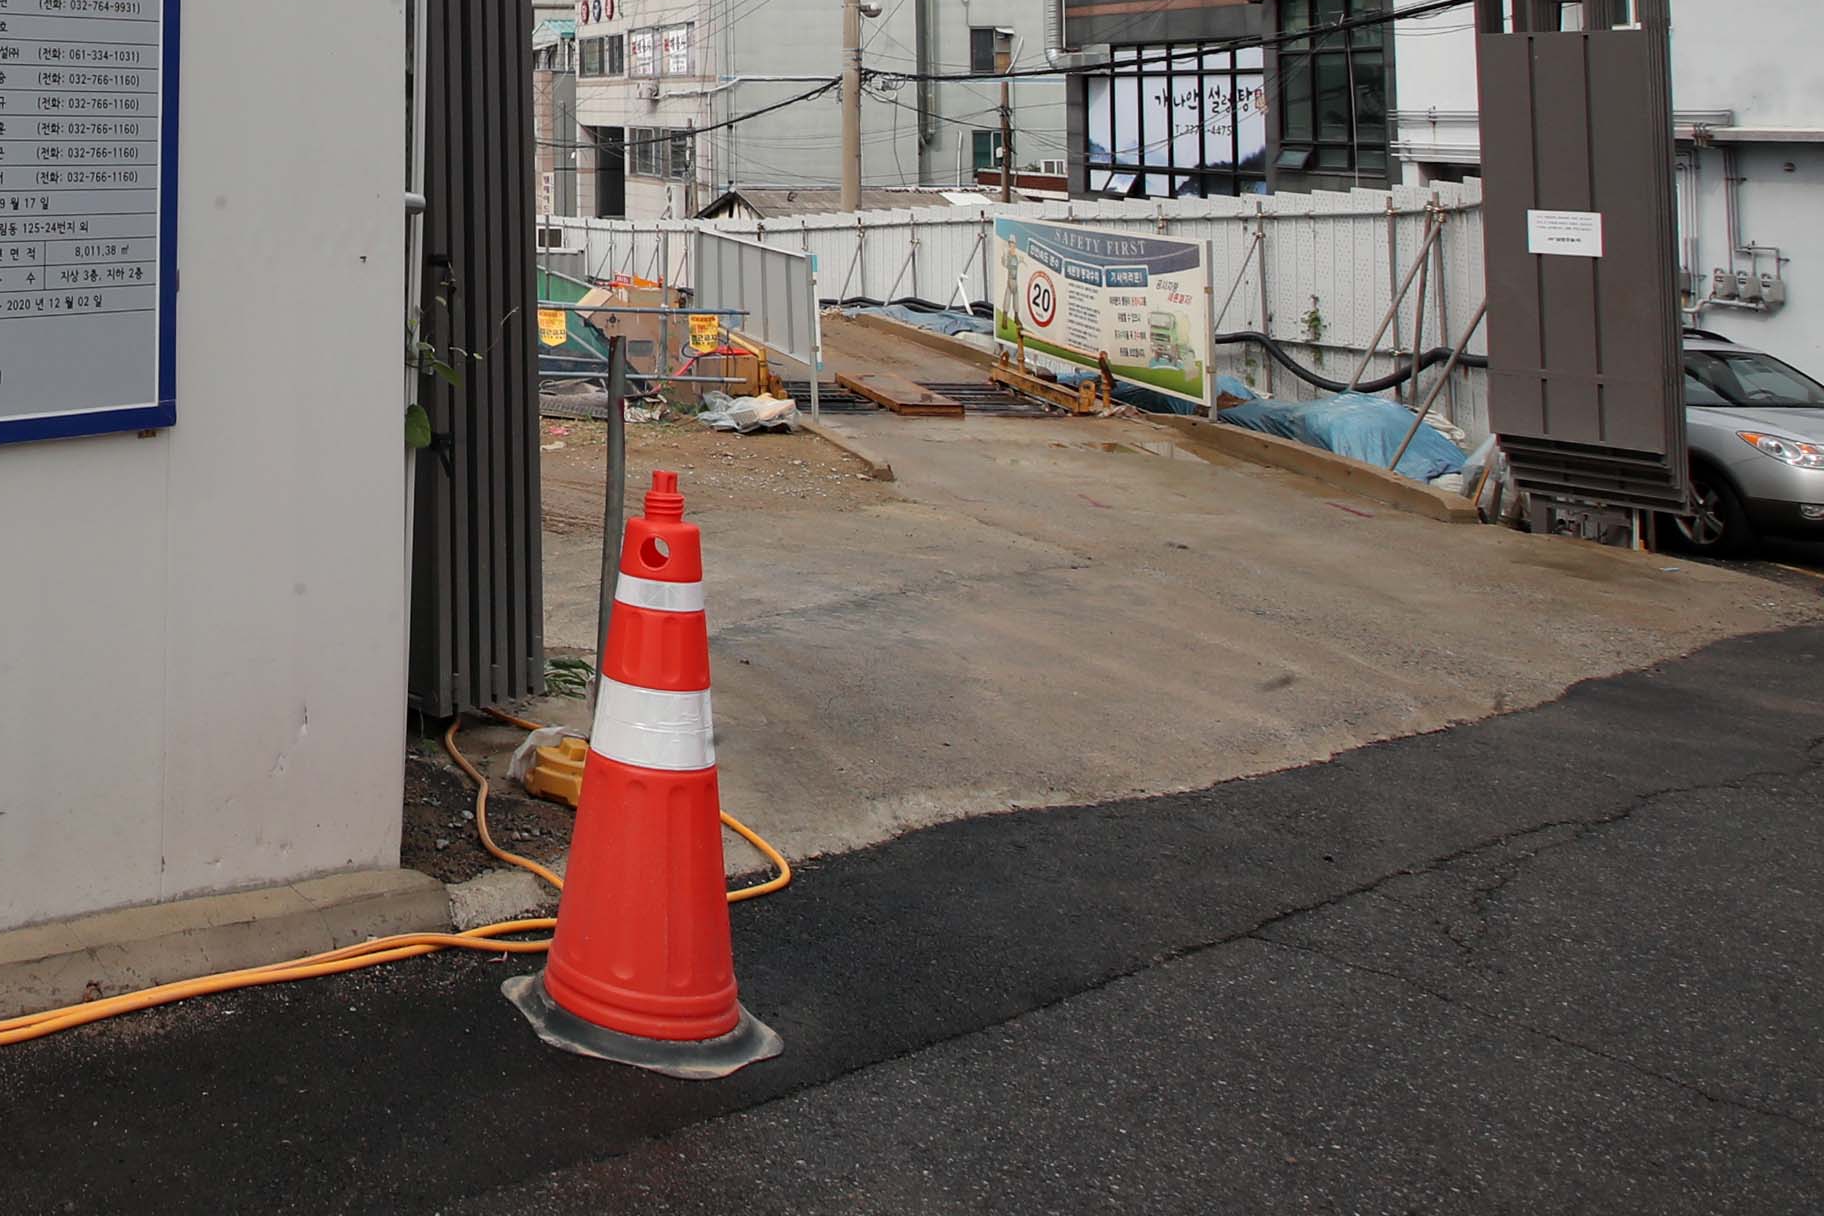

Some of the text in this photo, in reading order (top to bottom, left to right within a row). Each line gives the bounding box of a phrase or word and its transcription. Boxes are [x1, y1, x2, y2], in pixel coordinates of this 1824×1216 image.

[24, 198, 36, 209] 17
[40, 197, 49, 210] 일
[23, 221, 75, 235] 125-24번지
[1055, 230, 1146, 256] SAFETY FIRST
[7, 299, 31, 311] 2020
[35, 298, 44, 311] 년
[49, 297, 60, 309] 12
[78, 296, 89, 307] 02
[94, 295, 103, 308] 일
[1031, 282, 1051, 313] 20
